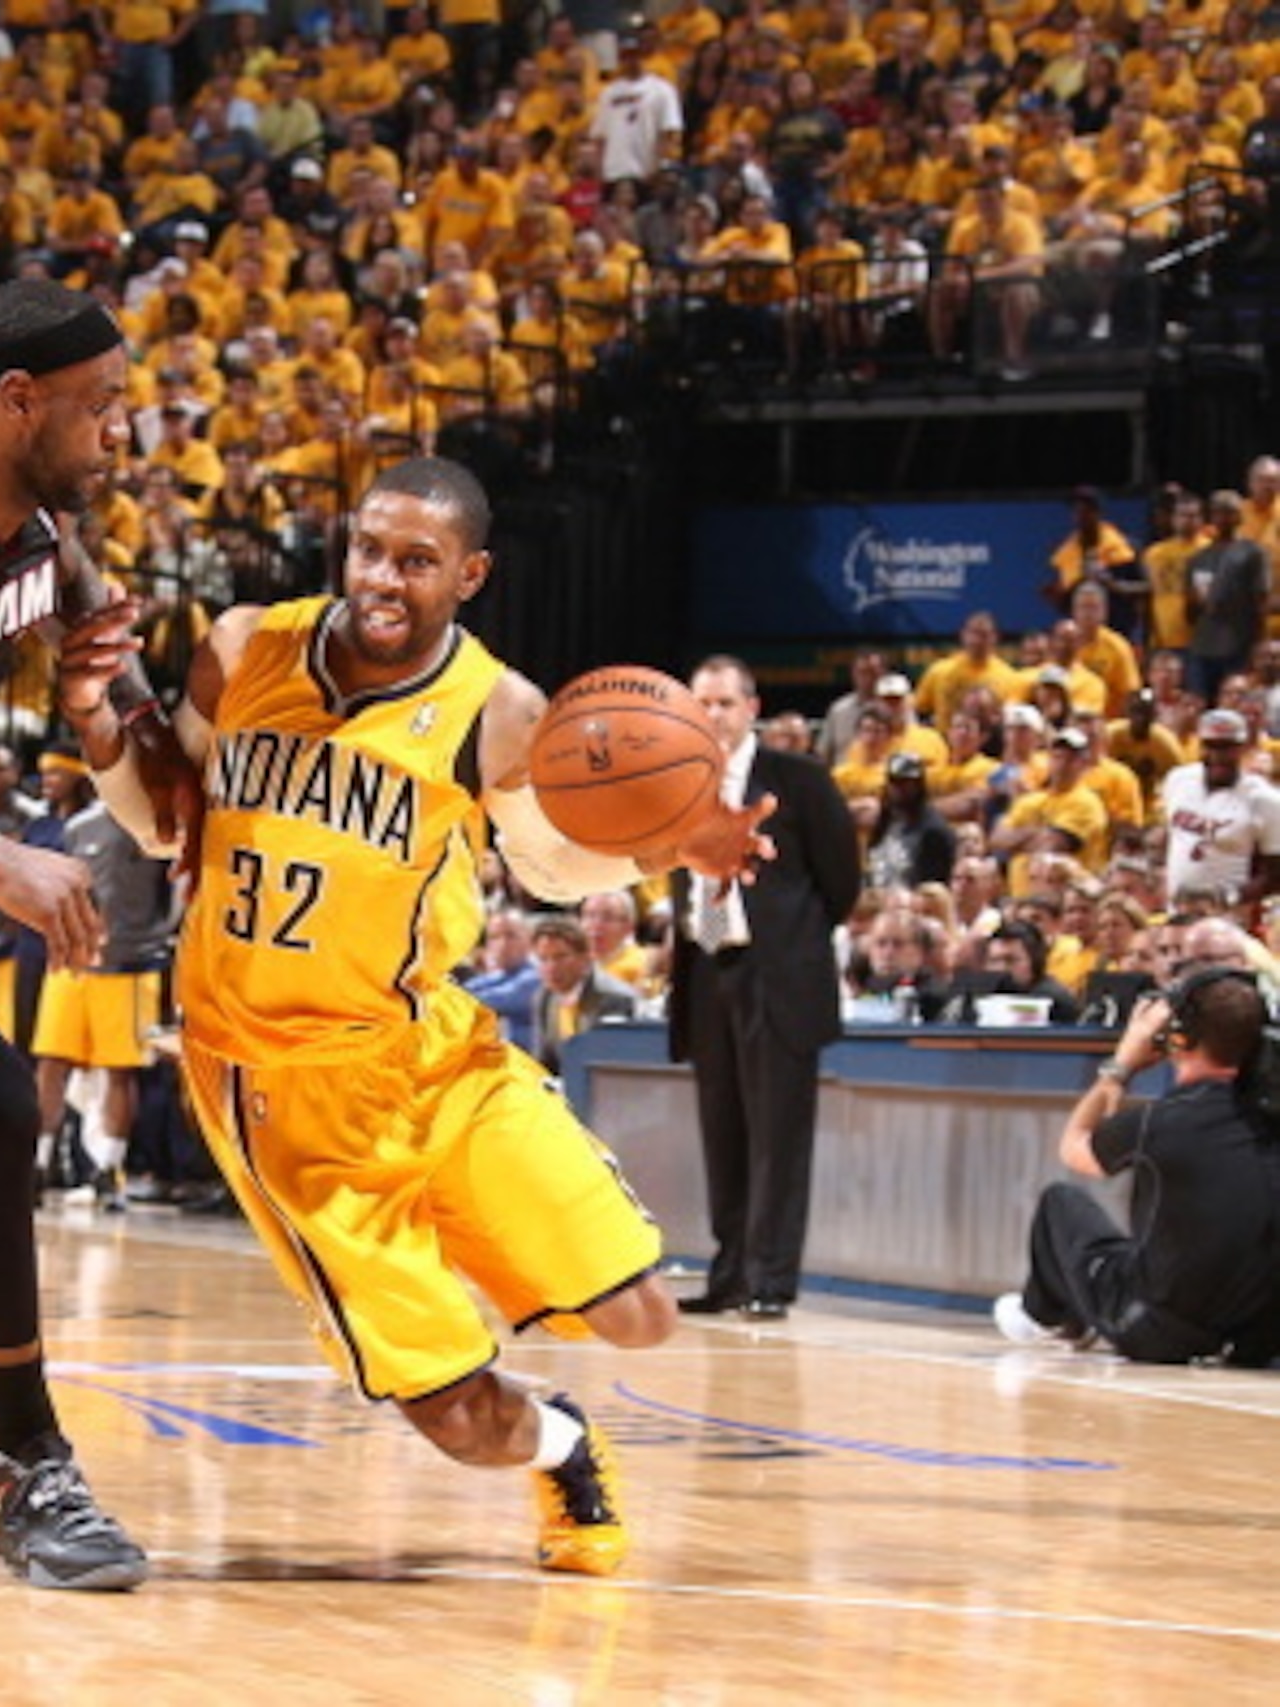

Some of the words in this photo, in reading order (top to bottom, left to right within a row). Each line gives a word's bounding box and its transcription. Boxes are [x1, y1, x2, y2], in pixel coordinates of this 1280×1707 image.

[865, 538, 990, 567] Washington
[873, 566, 967, 588] National
[224, 849, 322, 952] 32
